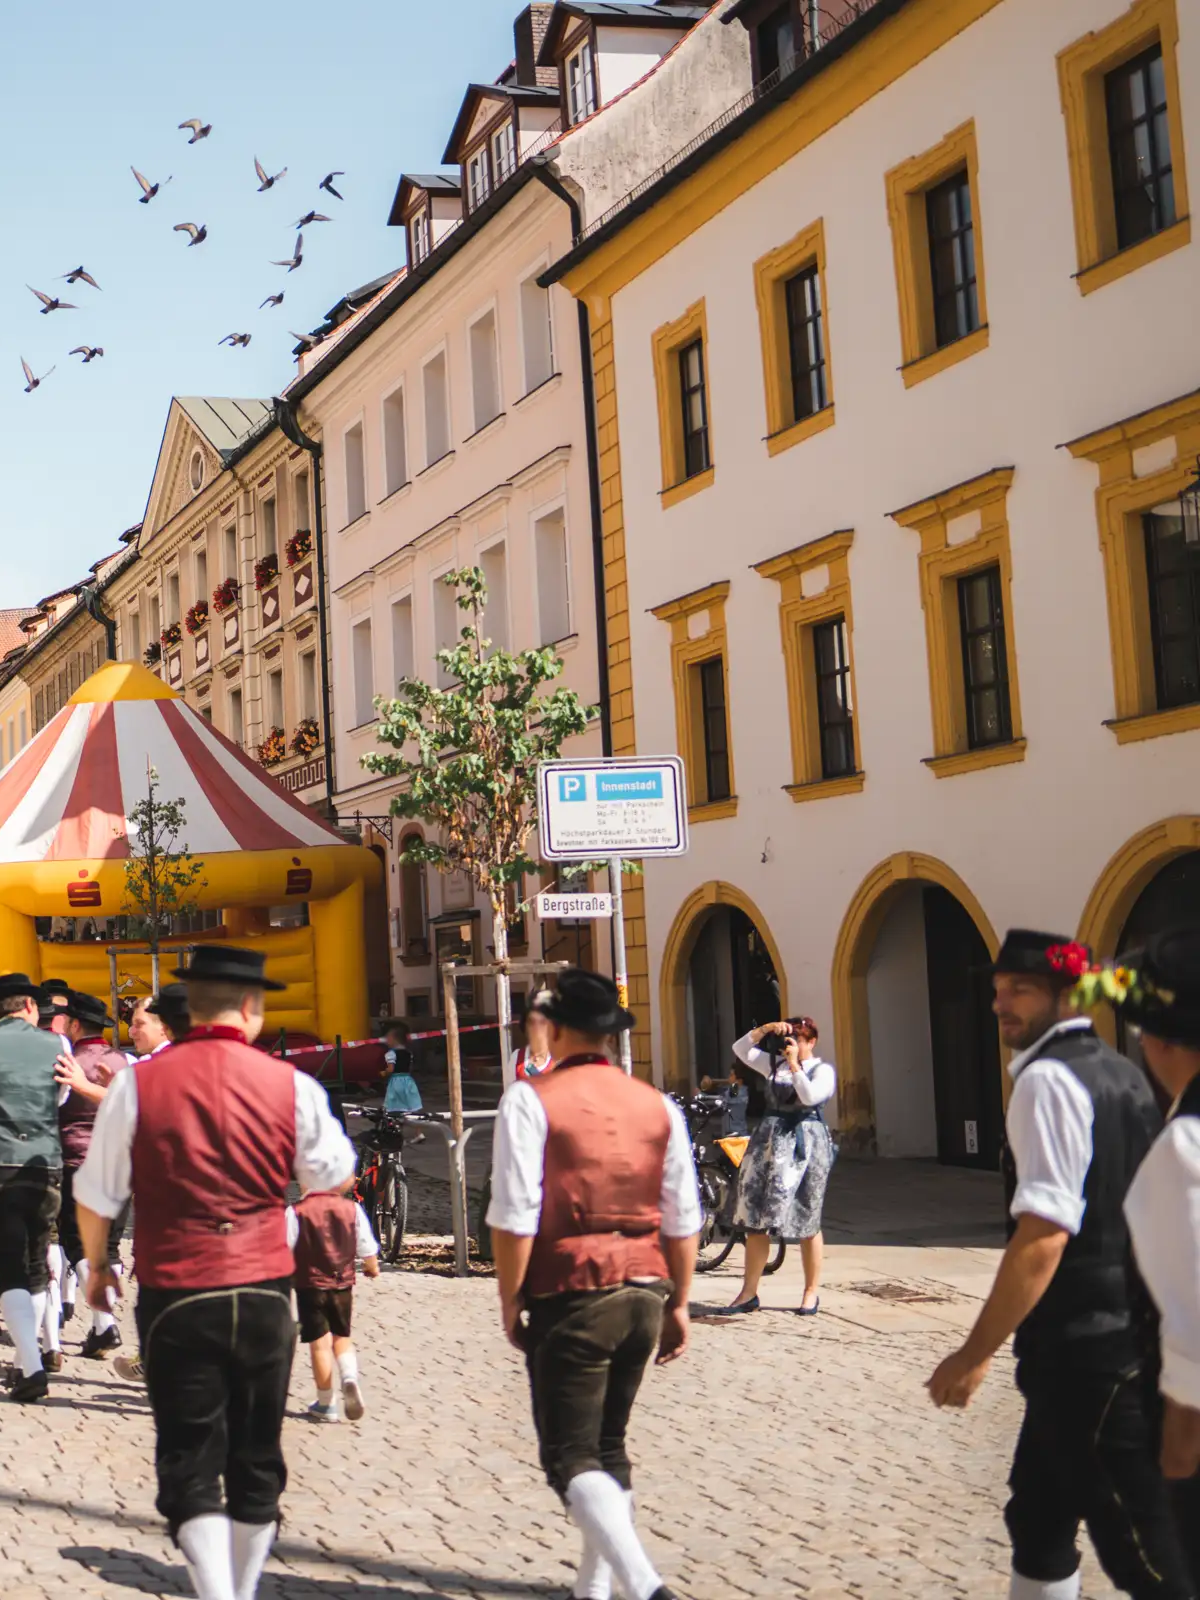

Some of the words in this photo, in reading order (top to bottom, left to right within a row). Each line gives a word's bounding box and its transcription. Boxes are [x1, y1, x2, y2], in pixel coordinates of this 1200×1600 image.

[563, 777, 580, 800] P
[601, 780, 656, 793] Innenstadt
[635, 827, 667, 836] Stunden
[543, 897, 606, 914] Bergstraße
